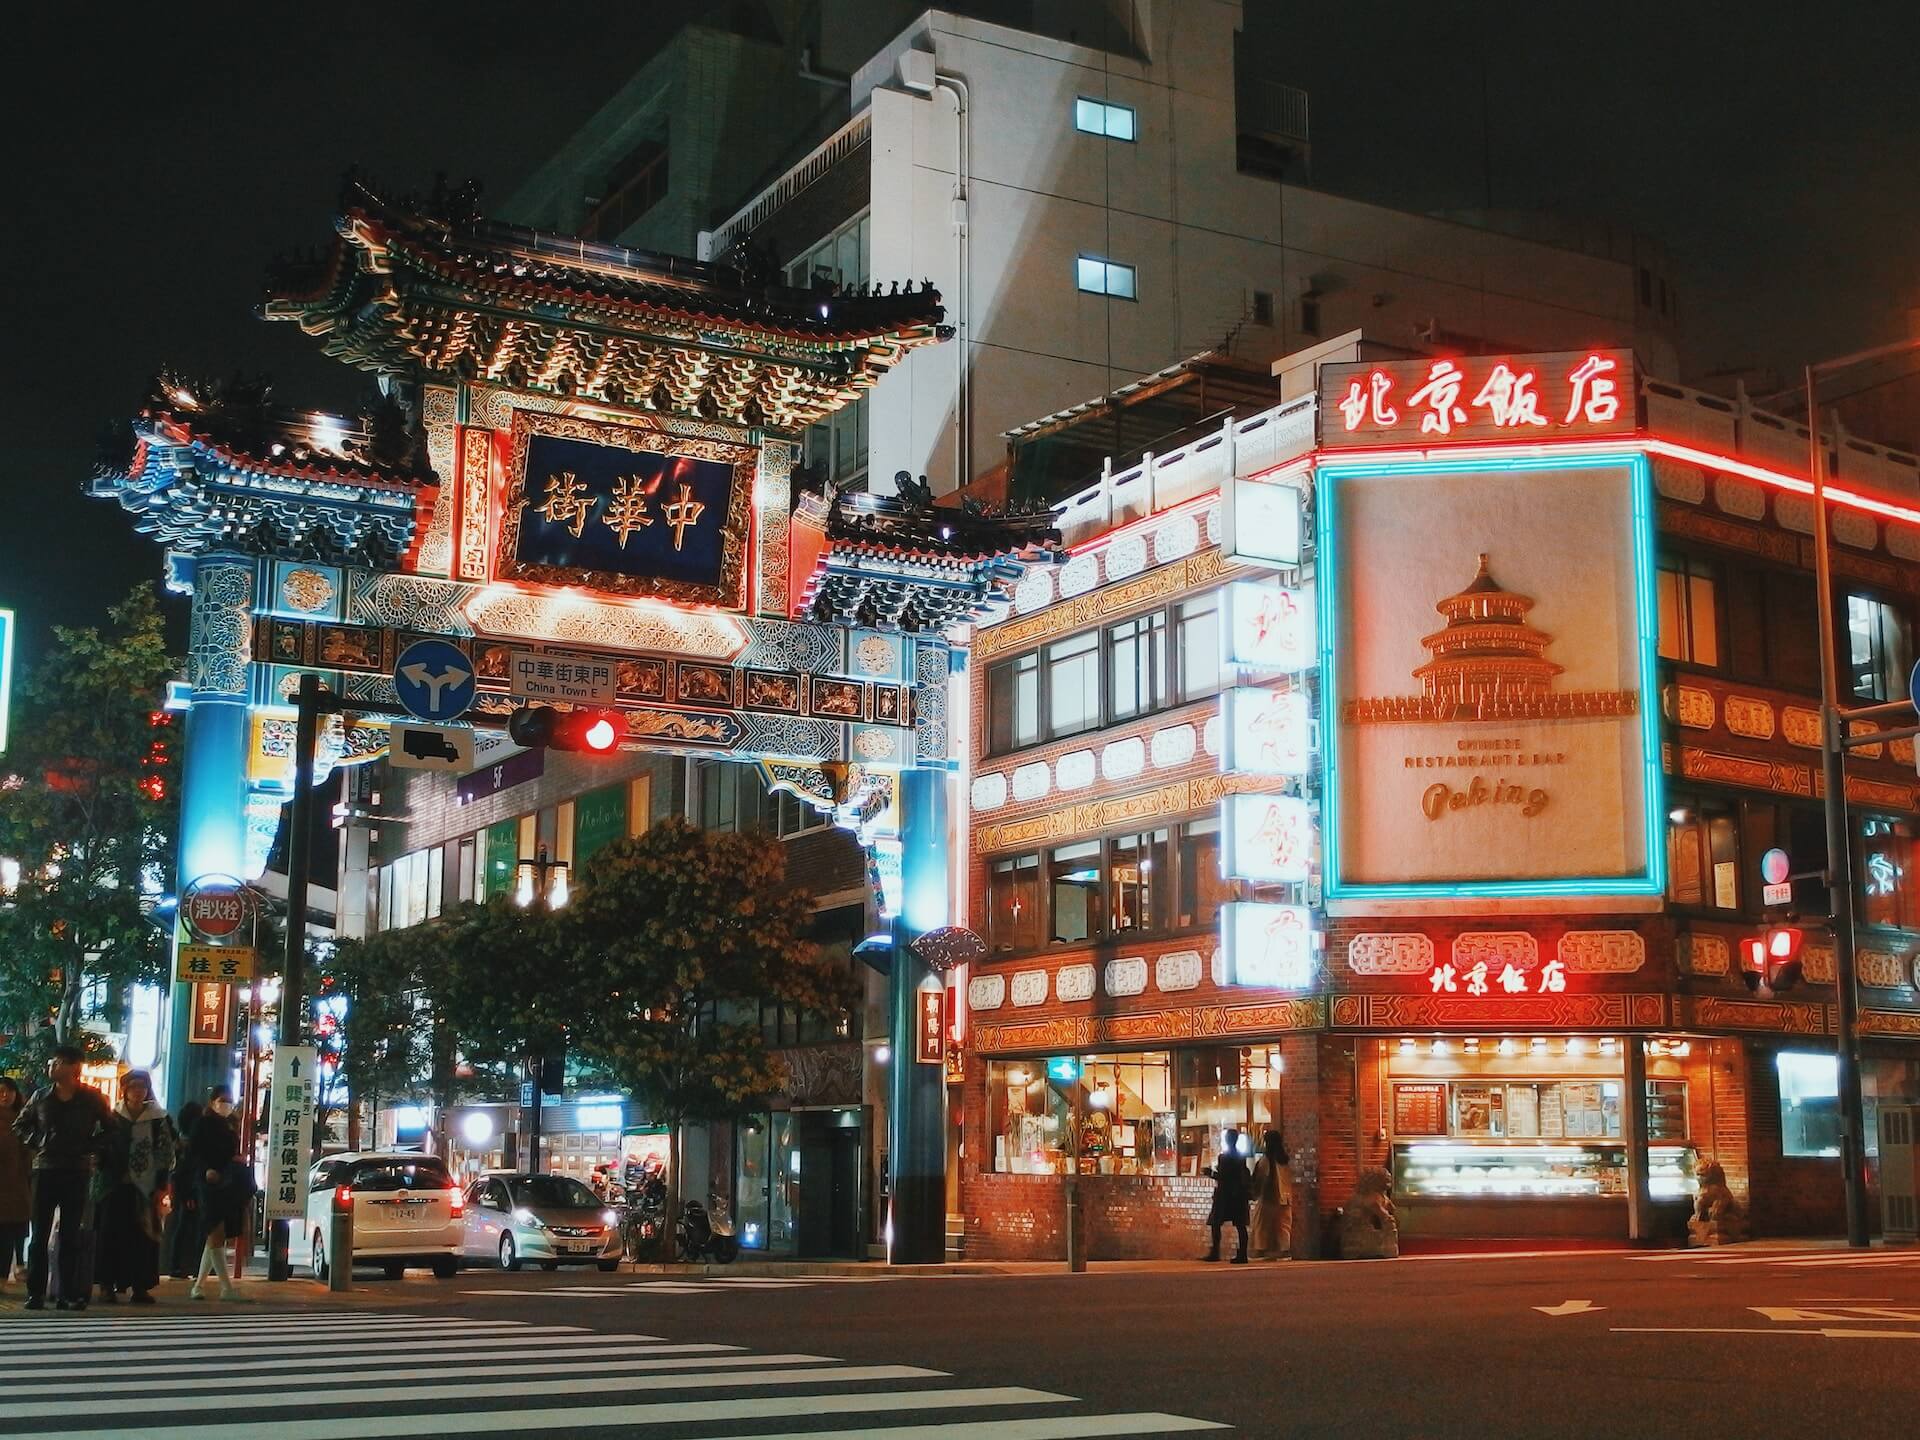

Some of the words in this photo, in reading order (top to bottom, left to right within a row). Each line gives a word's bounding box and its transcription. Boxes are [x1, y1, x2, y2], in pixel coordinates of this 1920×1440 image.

[1338, 354, 1622, 435] 北京飯店
[518, 659, 609, 686] 中華街東門
[526, 680, 555, 694] China
[560, 684, 587, 697] Town
[591, 688, 599, 698] E
[1456, 738, 1522, 752] CHINESE
[1403, 754, 1513, 769] RESTAURANT
[1532, 752, 1569, 766] BAR
[494, 765, 503, 788] 5F
[1421, 775, 1550, 821] Peking
[195, 899, 239, 921] 消火栓
[188, 957, 240, 974] 桂宮
[1427, 958, 1568, 998] 北京飯店
